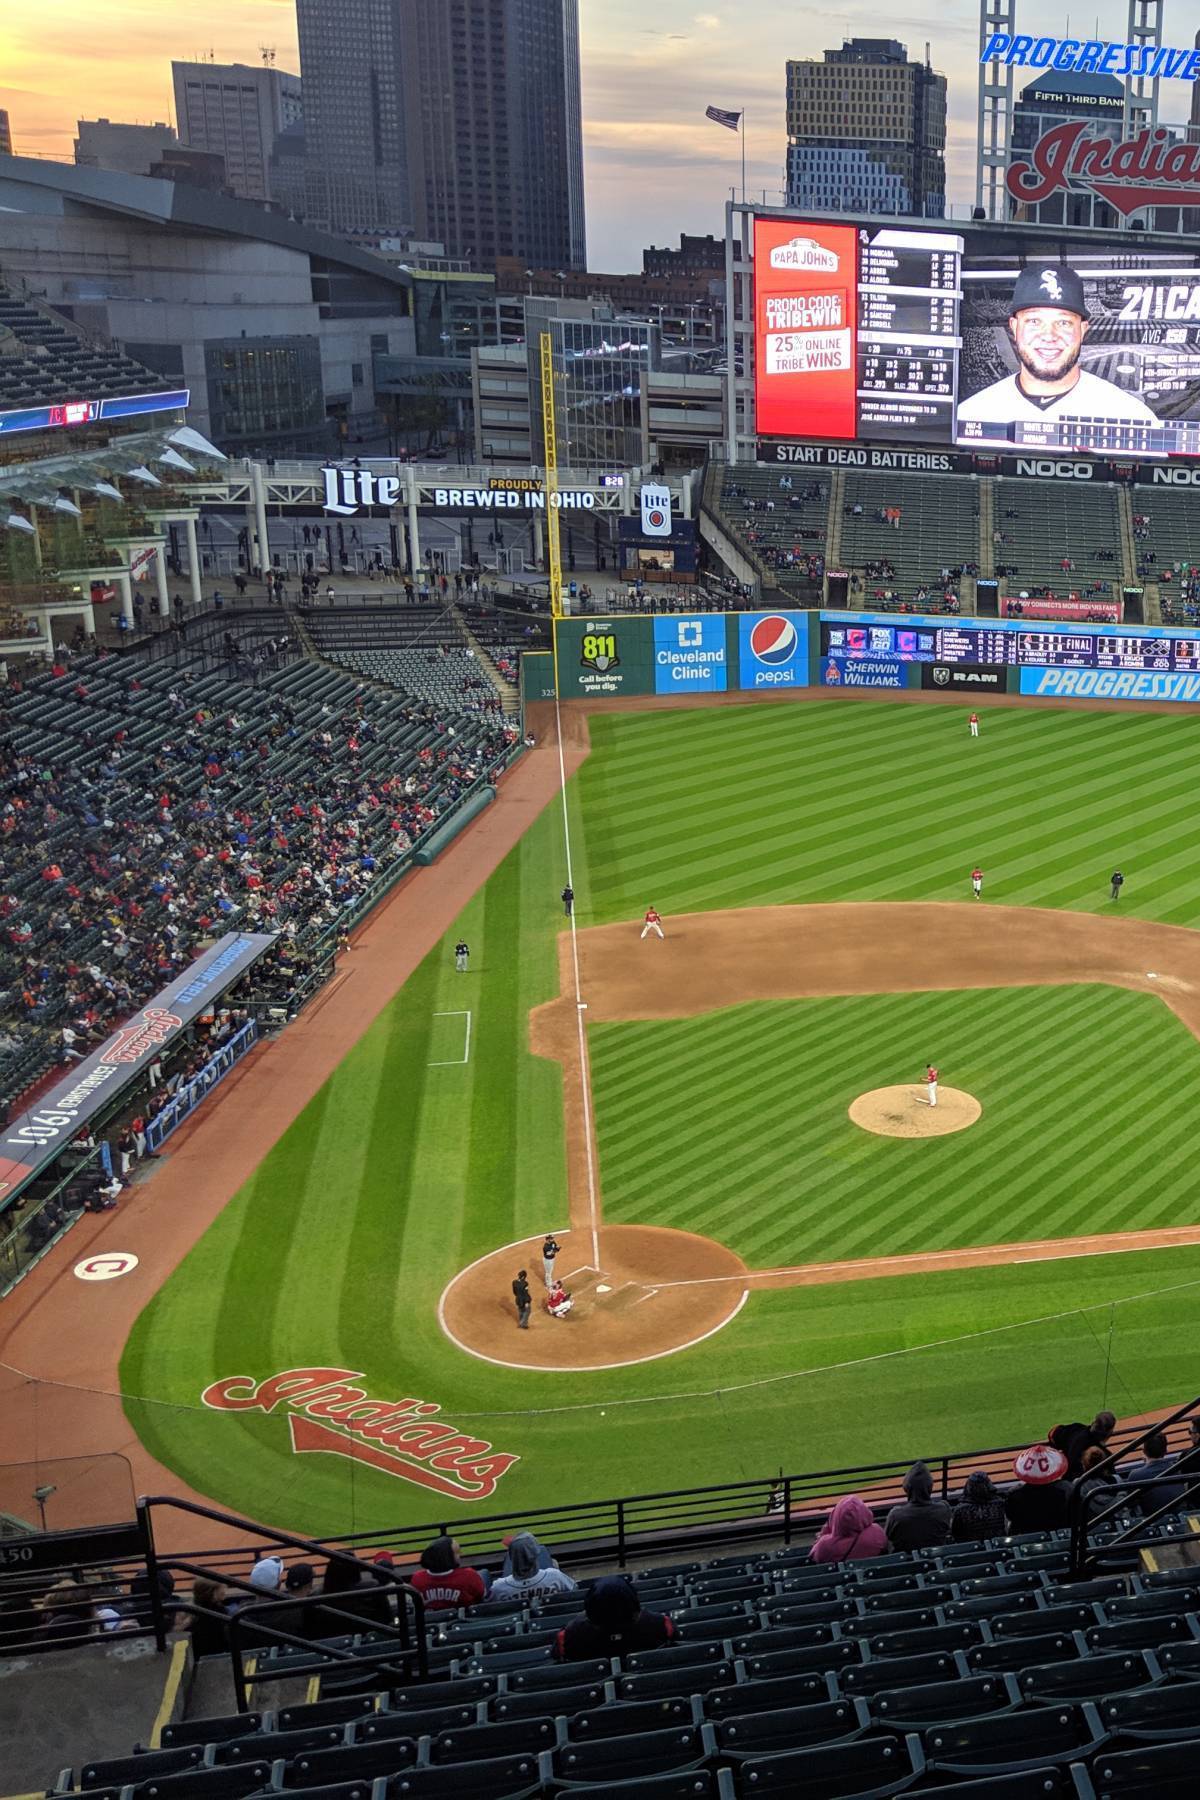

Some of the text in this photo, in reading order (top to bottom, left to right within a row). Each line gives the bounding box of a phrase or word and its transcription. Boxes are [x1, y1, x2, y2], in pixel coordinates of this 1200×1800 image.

[1035, 91, 1063, 102] FIFTH
[1064, 93, 1097, 105] THIRD
[774, 250, 799, 264] PAPA
[766, 297, 805, 313] PROMO
[1119, 286, 1155, 320] 21
[766, 306, 841, 329] TRIBEWIN
[1141, 329, 1162, 344] AVG
[805, 338, 841, 351] ONLINE
[904, 347, 912, 356] 75
[776, 352, 842, 370] TRIBE WINS
[893, 360, 898, 368] 2
[870, 369, 875, 377] 2
[777, 445, 953, 470] START DEAD BATTERIES.
[1016, 459, 1093, 479] NOCO
[320, 467, 400, 515] Lite
[490, 478, 543, 490] PROUDLY
[435, 489, 595, 509] BREWED IN OHIO
[644, 494, 668, 510] Lite
[848, 630, 914, 651] C C
[872, 628, 890, 639] FOX
[583, 636, 615, 659] 811
[872, 641, 891, 650] GO
[1066, 639, 1090, 651] FINAL
[657, 648, 724, 665] Cleveland
[672, 665, 710, 680] Clinic
[845, 660, 900, 674] SHERWIN
[755, 669, 794, 685] pepsi
[844, 672, 902, 687] WILLIAMS.
[953, 672, 998, 683] RAM
[541, 689, 556, 697] 325
[585, 682, 618, 692] you dig.
[101, 1008, 182, 1064] Indians
[57, 1065, 118, 1108] ESTABLISHED
[7, 1109, 78, 1145] 1901
[201, 1366, 521, 1501] Indians
